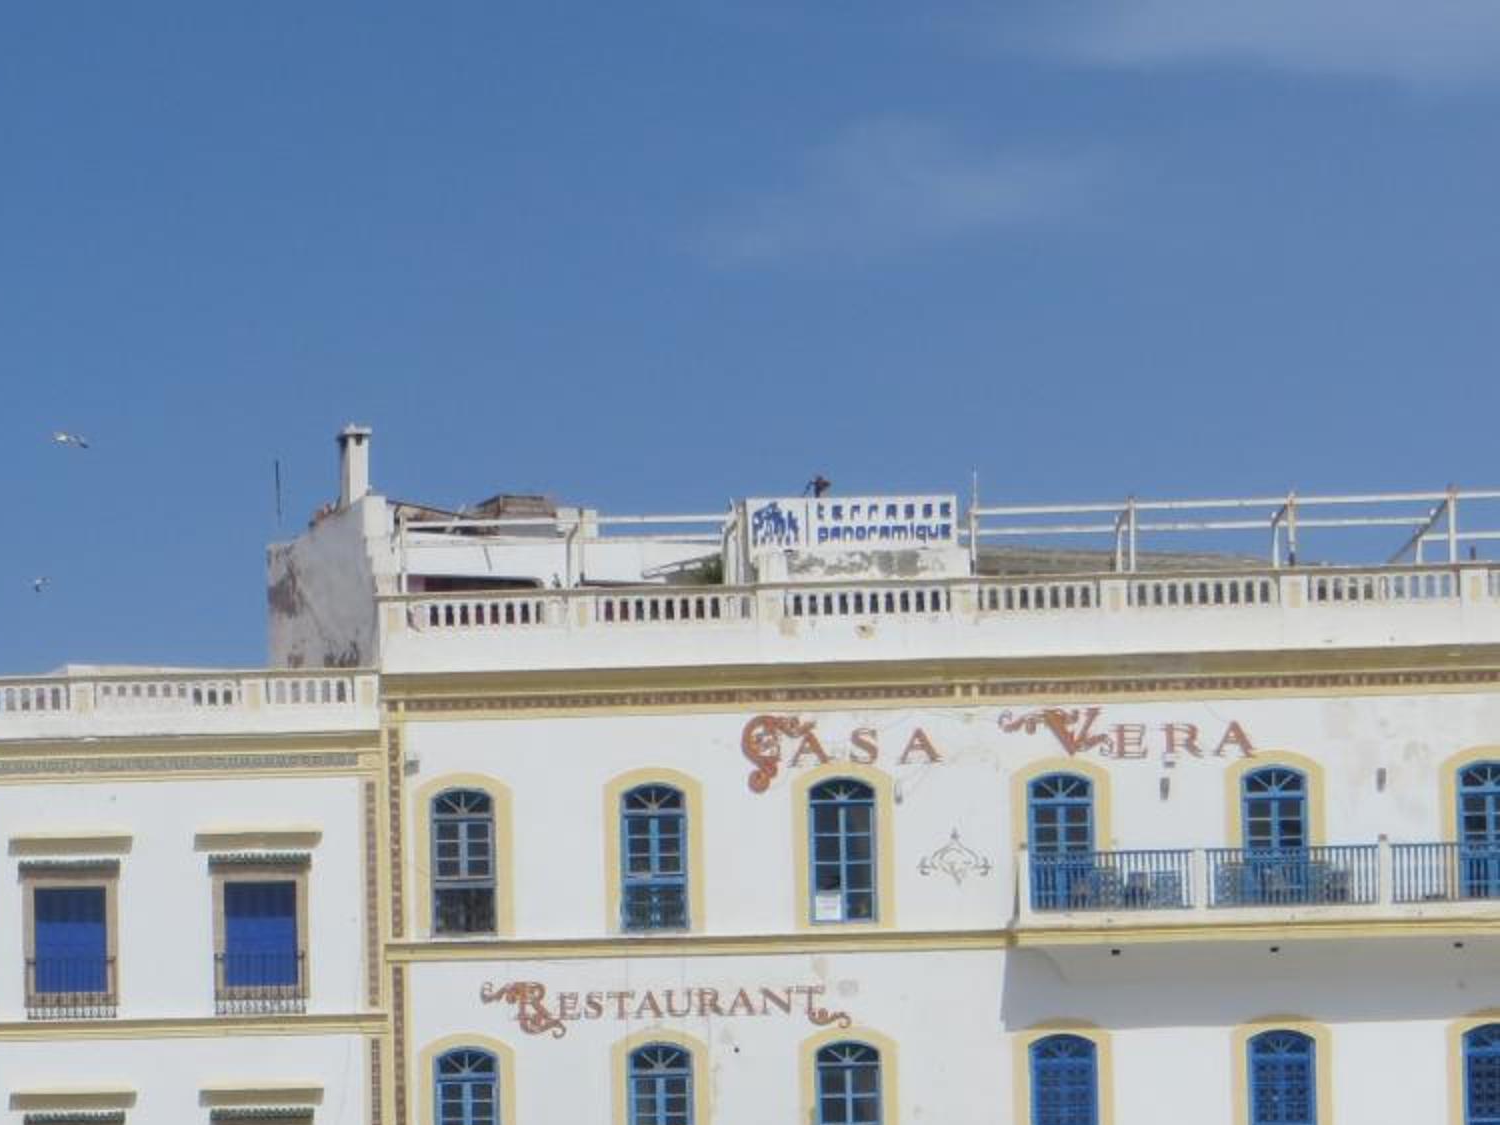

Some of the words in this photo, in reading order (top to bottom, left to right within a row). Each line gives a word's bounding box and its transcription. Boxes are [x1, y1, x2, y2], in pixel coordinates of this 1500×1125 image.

[817, 503, 951, 520] terrasse
[817, 523, 951, 543] panoramique
[741, 715, 943, 793] CASA
[999, 707, 1255, 760] VERA
[481, 981, 852, 1038] RESTAURANT
